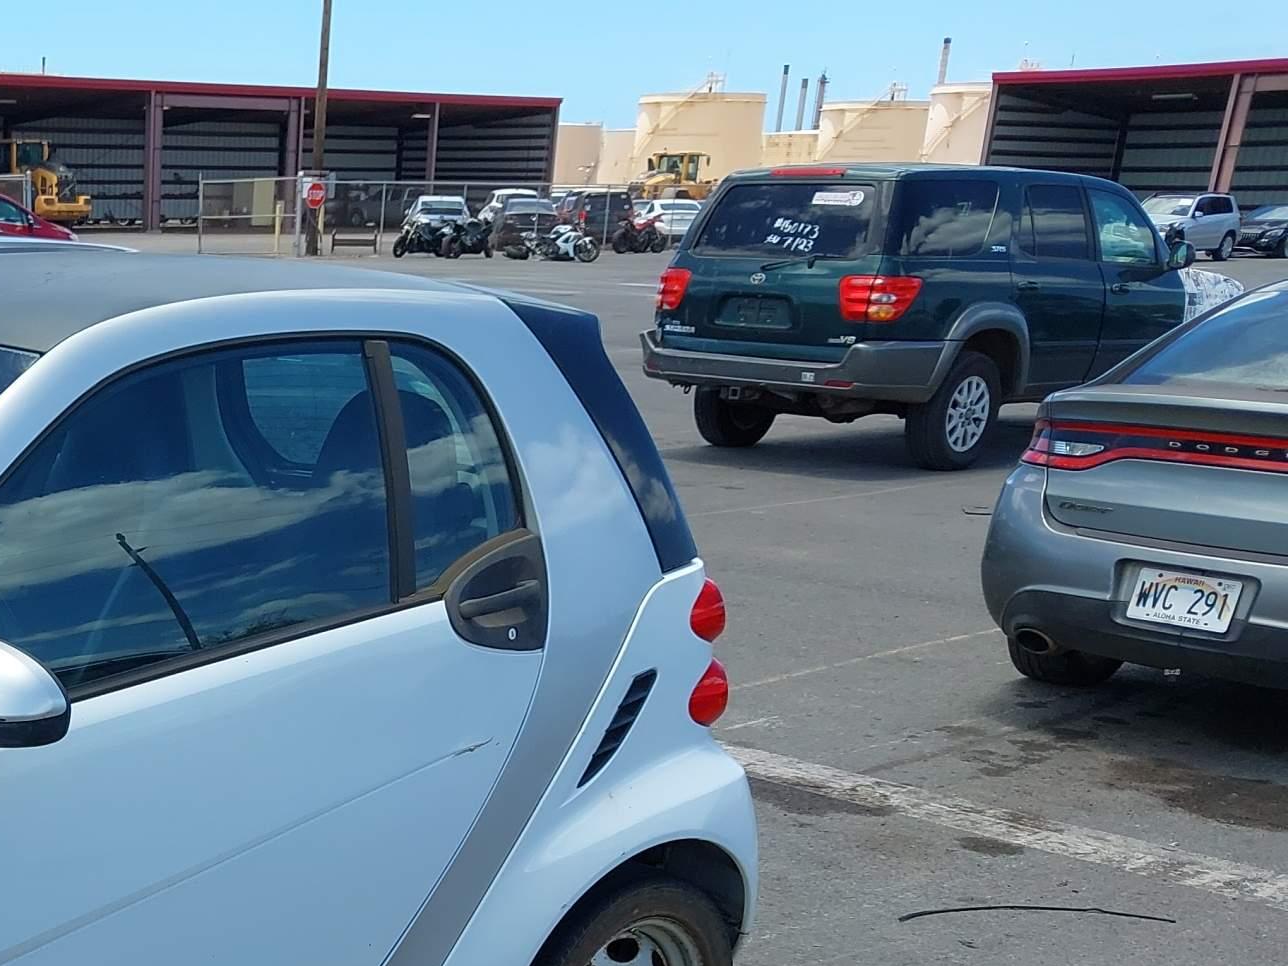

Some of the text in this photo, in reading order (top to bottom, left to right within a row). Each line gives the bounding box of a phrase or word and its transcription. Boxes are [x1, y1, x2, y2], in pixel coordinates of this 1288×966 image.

[308, 190, 325, 200] STOP
[1168, 441, 1288, 459] DODG
[1136, 581, 1229, 620] WVC 291
[1152, 612, 1201, 626] ALOHA STATE
